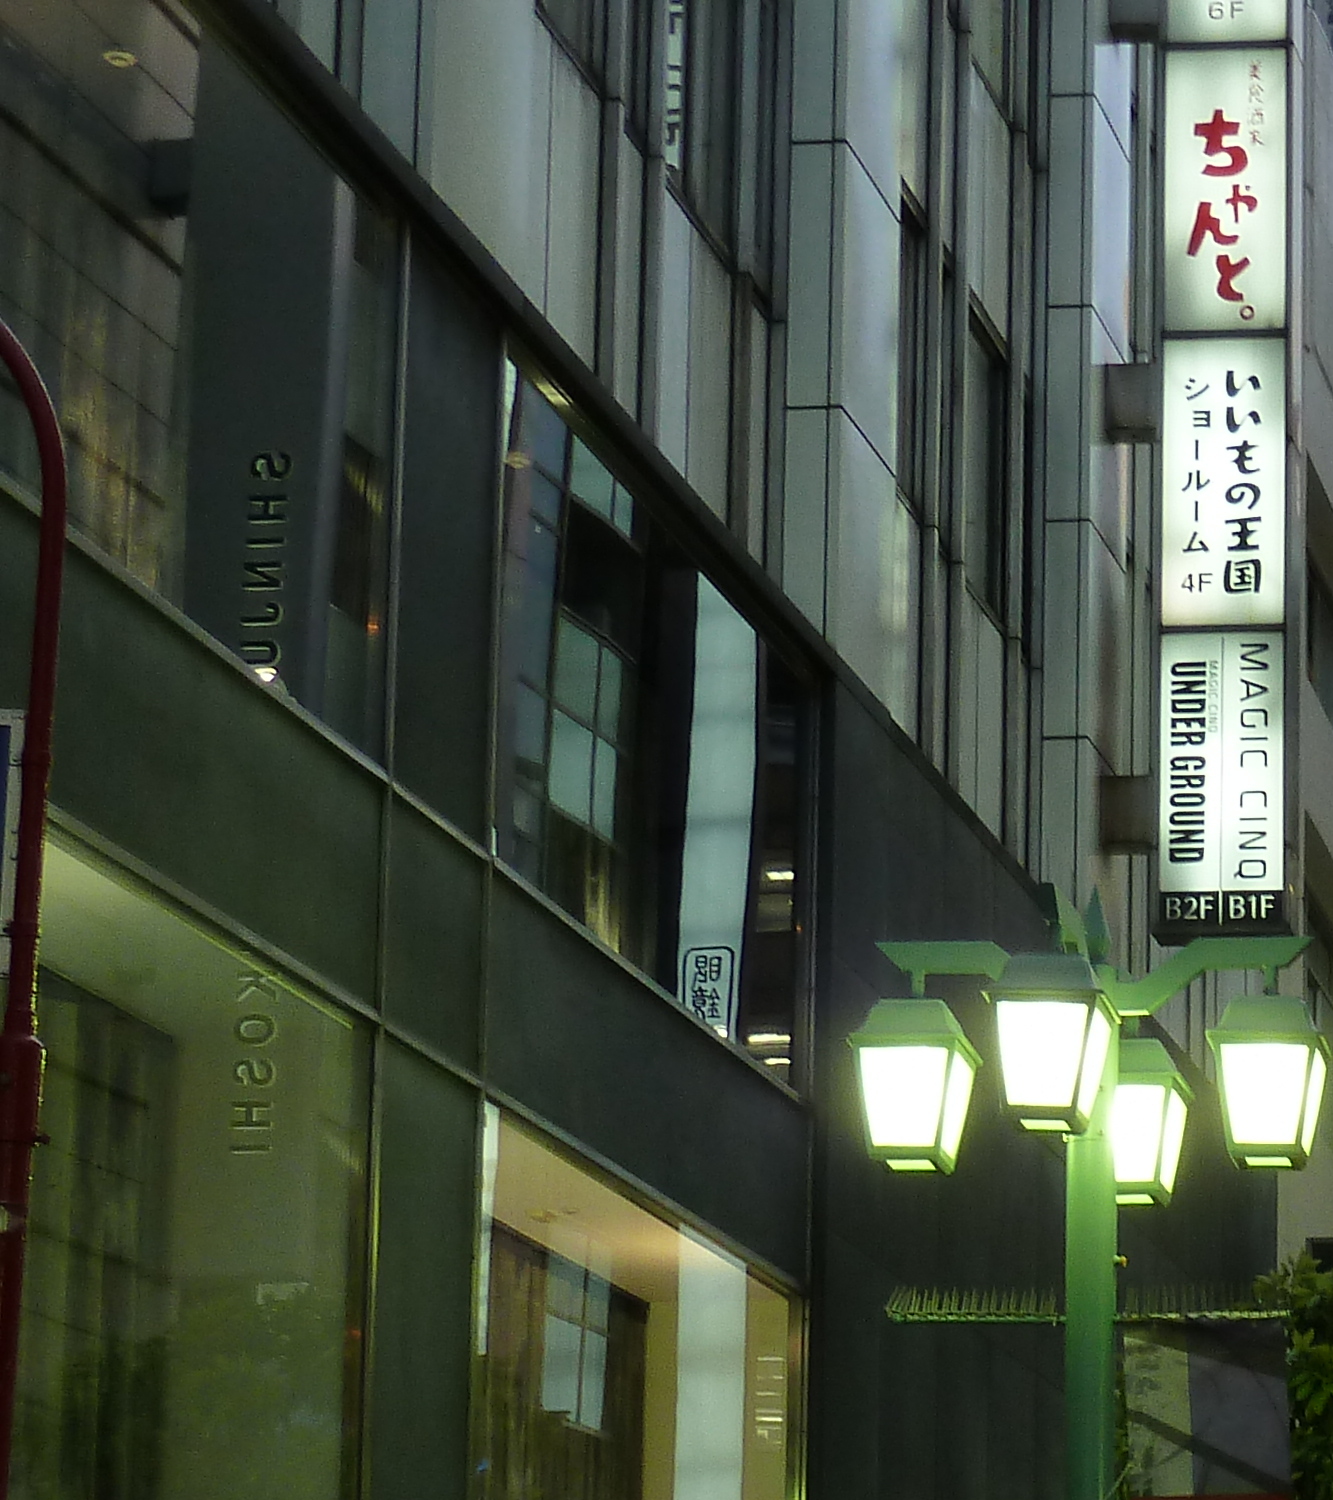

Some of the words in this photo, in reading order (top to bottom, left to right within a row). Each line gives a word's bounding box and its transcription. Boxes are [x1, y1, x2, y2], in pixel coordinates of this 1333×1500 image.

[1208, 1, 1244, 20] 6F
[1187, 109, 1258, 321] ちゃんと。
[1183, 376, 1212, 555] ショールーム
[1223, 368, 1262, 596] いいもの王国
[1181, 571, 1214, 595] 4F
[1170, 661, 1207, 748] UNDER
[1239, 642, 1270, 768] MAGIC
[1168, 755, 1206, 864] GROUND
[1233, 790, 1268, 880] CINQ
[1165, 895, 1214, 921] B2F
[1228, 893, 1276, 920] B1F
